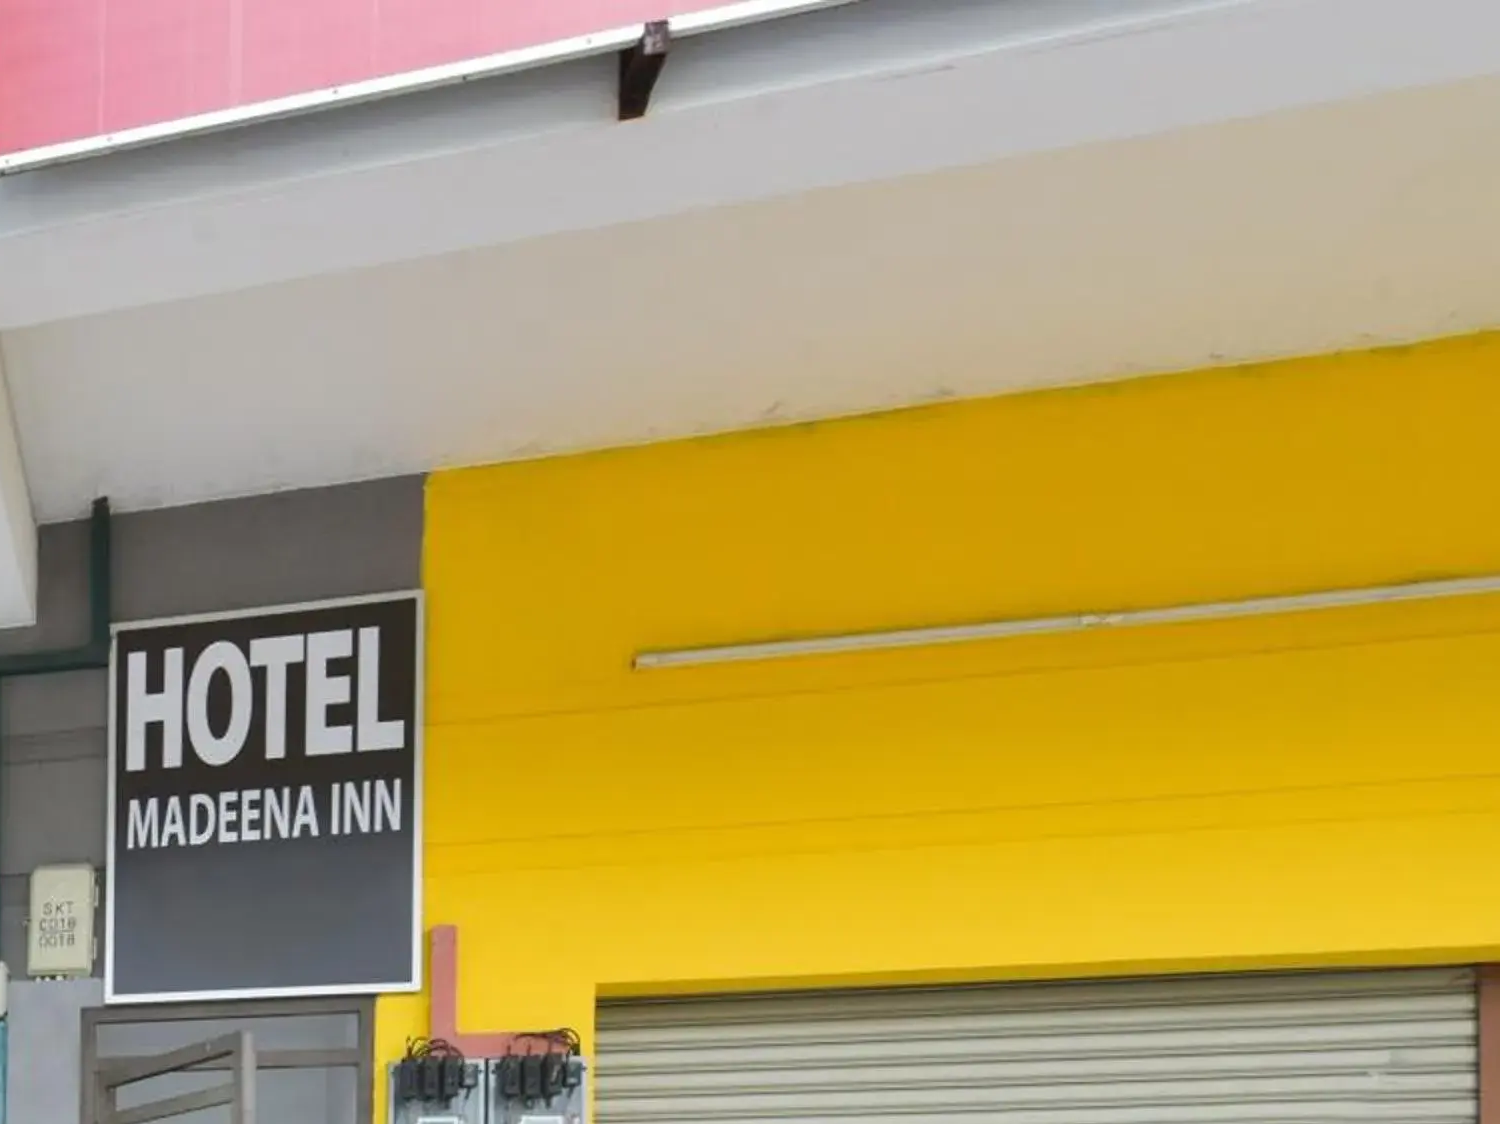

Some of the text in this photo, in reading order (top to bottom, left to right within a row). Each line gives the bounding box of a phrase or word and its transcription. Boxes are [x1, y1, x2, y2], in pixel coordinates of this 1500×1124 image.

[126, 626, 405, 771] HOTEL
[127, 778, 402, 849] MADEENA INN
[43, 901, 75, 915] SKT
